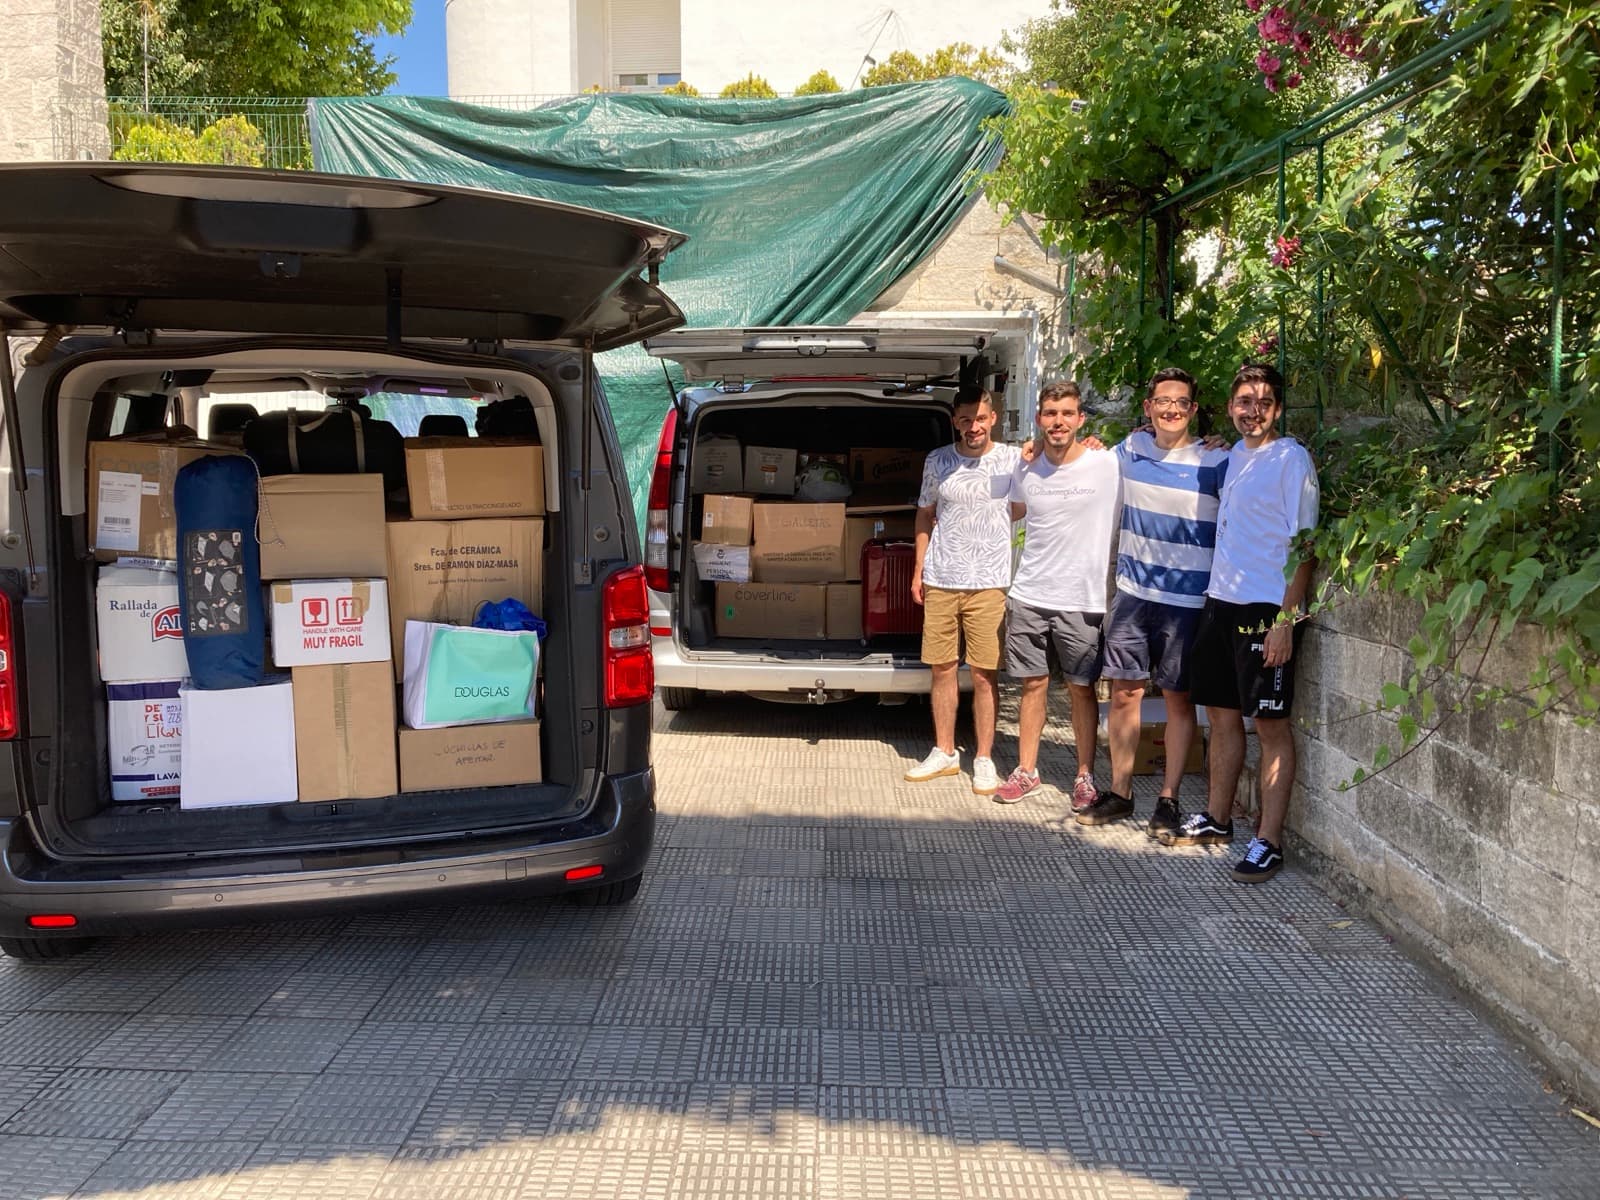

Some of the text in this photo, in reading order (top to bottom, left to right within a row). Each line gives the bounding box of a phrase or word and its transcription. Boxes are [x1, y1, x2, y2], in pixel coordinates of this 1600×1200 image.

[449, 547, 459, 555] de
[435, 561, 446, 570] DE
[110, 599, 158, 611] Rallada
[140, 610, 151, 618] de
[302, 625, 363, 635] HANDLE WITH CARE
[303, 635, 364, 649] MUY FRAGIL
[454, 686, 510, 698] DOUGLAS
[1259, 699, 1284, 710] FILA
